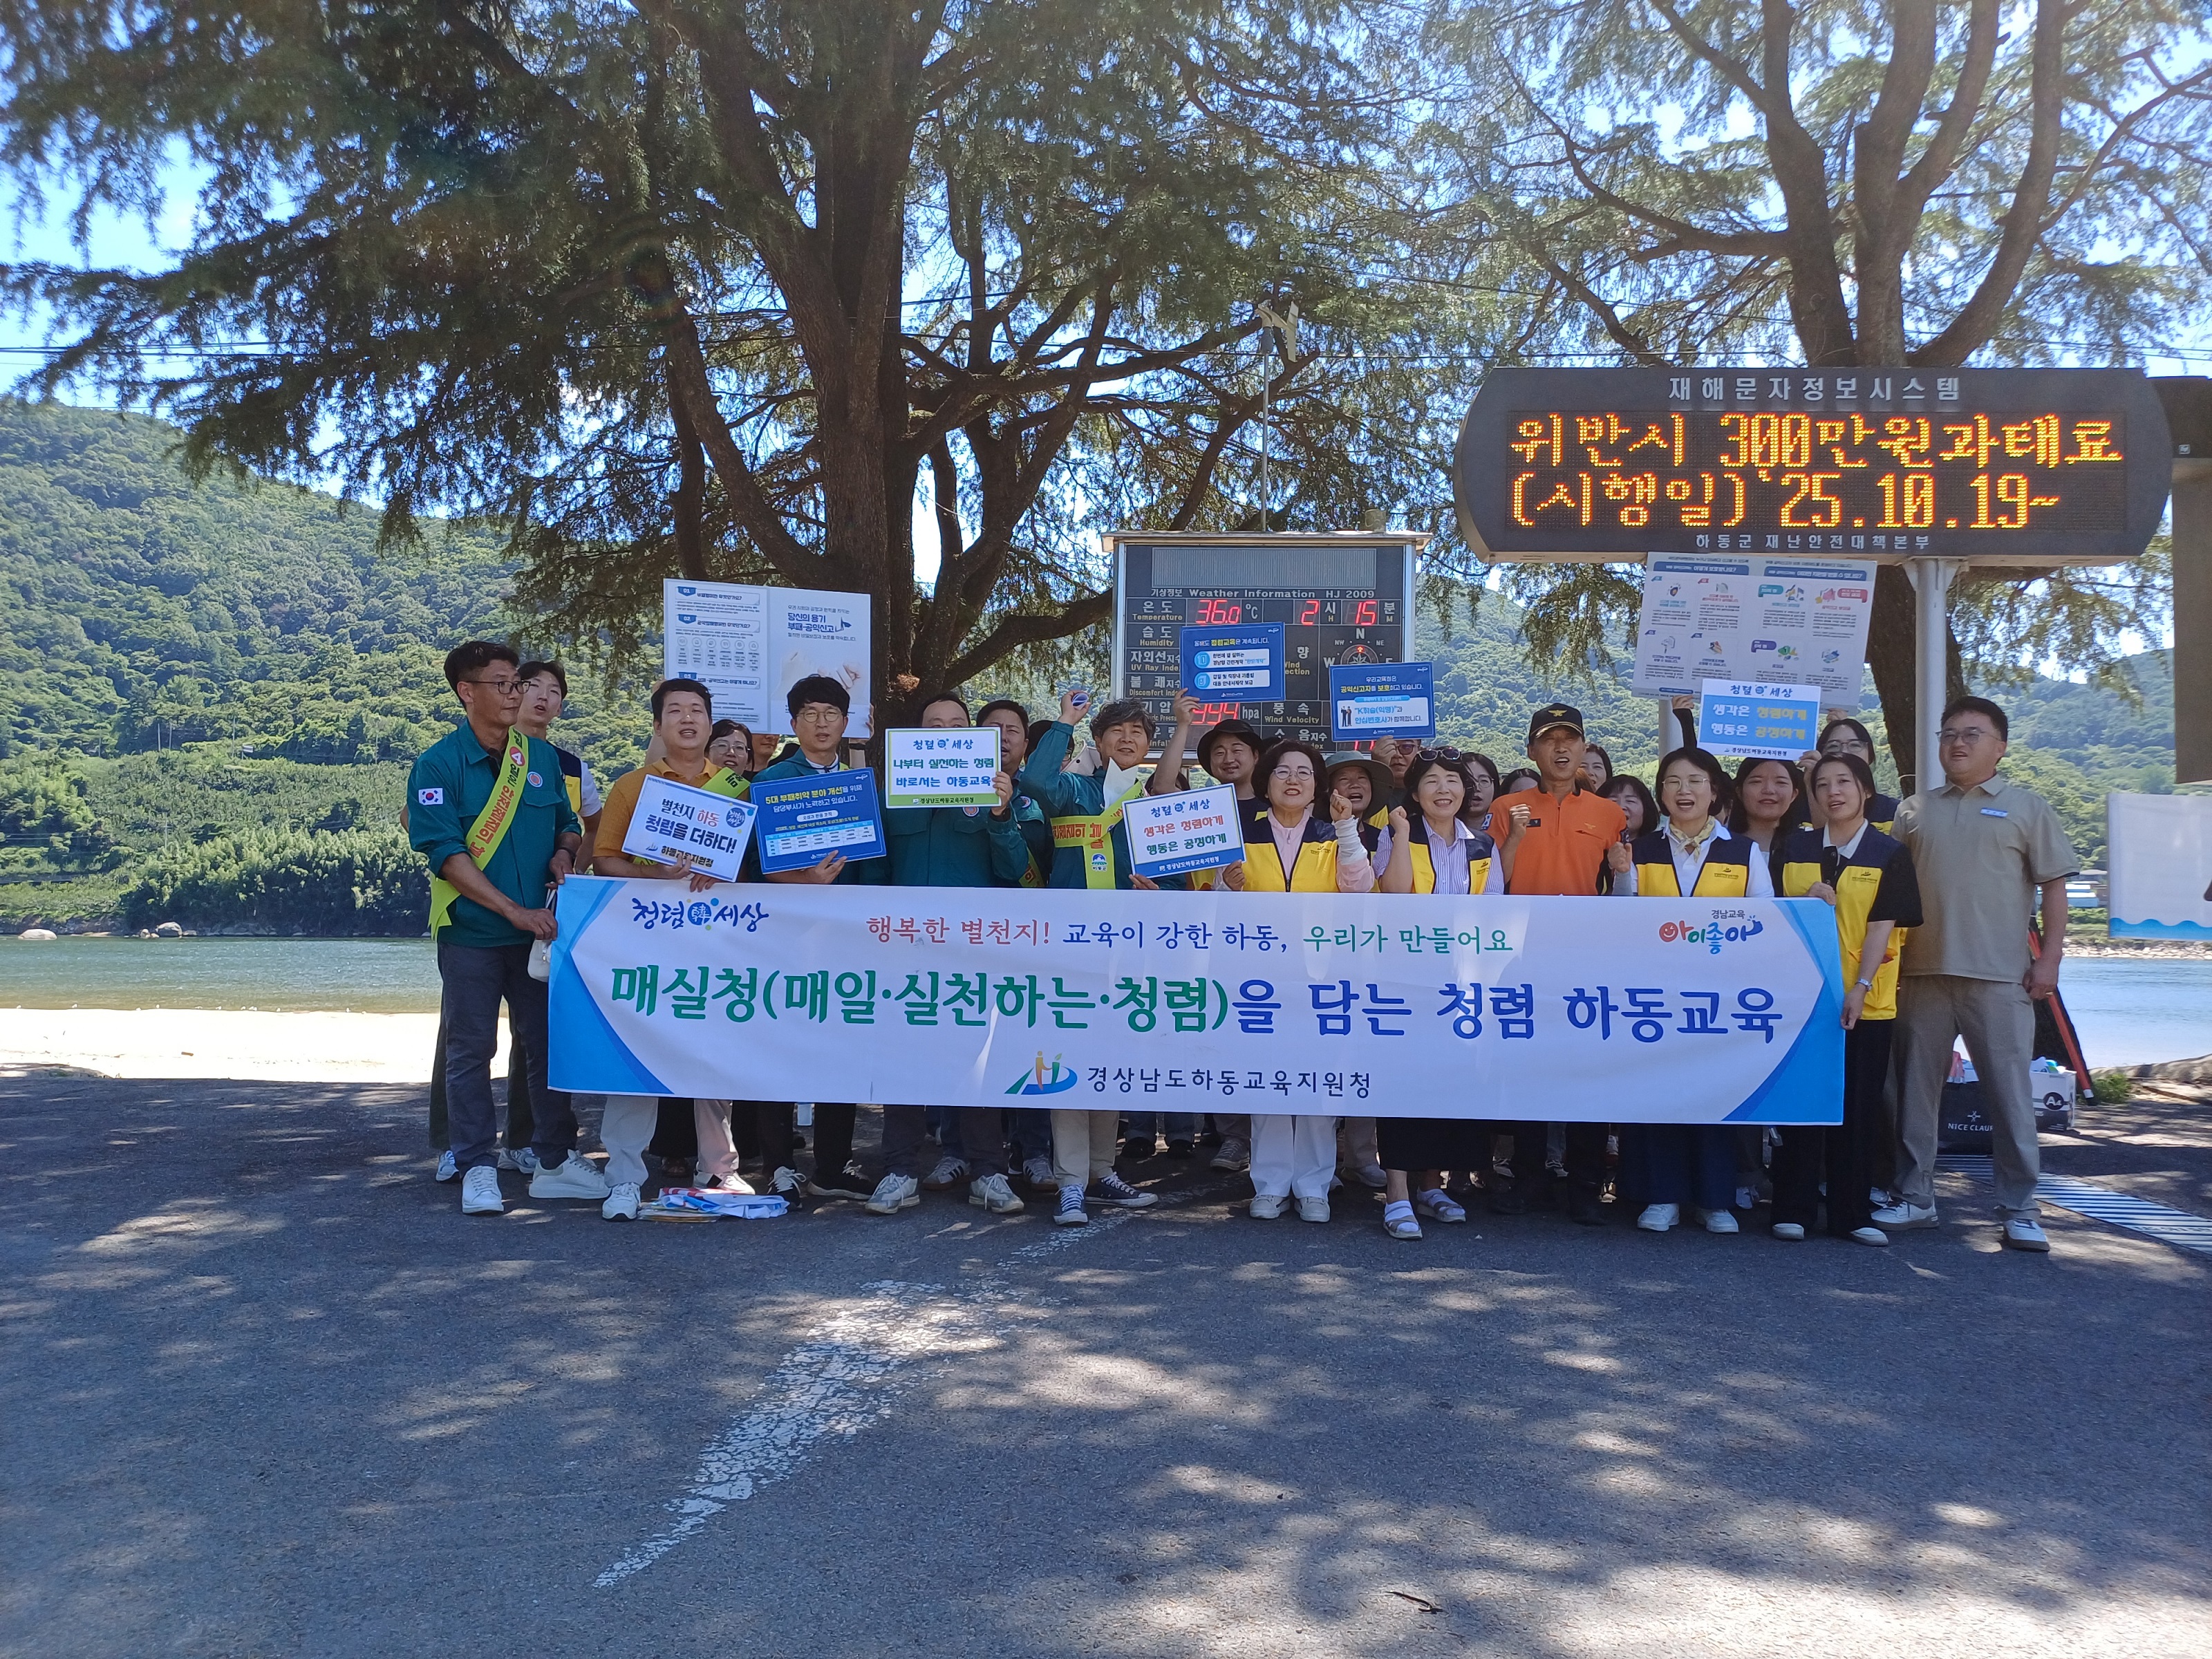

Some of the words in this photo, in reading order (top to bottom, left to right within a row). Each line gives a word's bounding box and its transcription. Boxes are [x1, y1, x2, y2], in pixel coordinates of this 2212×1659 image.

[1669, 376, 1959, 402] 재해문자정보시스템
[1510, 413, 1685, 468] 위반시
[1721, 413, 2122, 469] 300만원과태료
[1696, 534, 1750, 550] 하동군
[1765, 534, 1931, 551] 재난안전대책본부
[1151, 589, 1183, 597] 기상정보
[1189, 589, 1239, 598] Weather
[1244, 589, 1315, 598] Information
[1326, 590, 1342, 598] HJ
[1346, 590, 1374, 598] 2009
[1301, 601, 1318, 626] 2
[1324, 602, 1336, 615] 시
[1356, 601, 1377, 626] 15
[1383, 602, 1396, 615] 분
[788, 612, 809, 621] 당신의
[812, 615, 825, 623] 용기
[1356, 628, 1365, 639] N
[1770, 688, 1792, 697] 세상
[1242, 706, 1259, 720] hpa
[1712, 704, 1750, 717] 생각은
[1711, 723, 1748, 736] 행동은
[952, 739, 974, 749] 세상
[894, 759, 924, 769] 나부터
[928, 759, 968, 769] 실천하는
[974, 758, 994, 768] 청렴
[897, 777, 940, 787] 바로서는
[947, 776, 991, 787] 하동교육
[832, 795, 858, 805] 있습니다.
[1189, 798, 1210, 811] 세상
[697, 809, 720, 827] 하동
[1144, 823, 1175, 838] 생각은
[1181, 815, 1224, 831] 청렴하게
[646, 814, 688, 841] 청렴을
[690, 827, 738, 854] 더하다!
[1147, 841, 1179, 855] 행동은
[1184, 833, 1227, 850] 공정하게
[1711, 909, 1745, 919] 경남교육
[866, 916, 950, 946] 행복한
[960, 917, 1050, 947] 별천지!
[1063, 921, 1145, 950] 교육이
[1156, 921, 1212, 952] 강한
[1223, 925, 1287, 954] 하동,
[1302, 924, 1390, 954] 우리가
[1398, 925, 1514, 955] 만들어요
[1308, 980, 1413, 1038] 담는
[1436, 983, 1535, 1040] 청렴
[1563, 987, 1783, 1044] 하동교육
[1087, 1067, 1371, 1099] 경상남도하동교육지원청
[2046, 1096, 2062, 1105] A4
